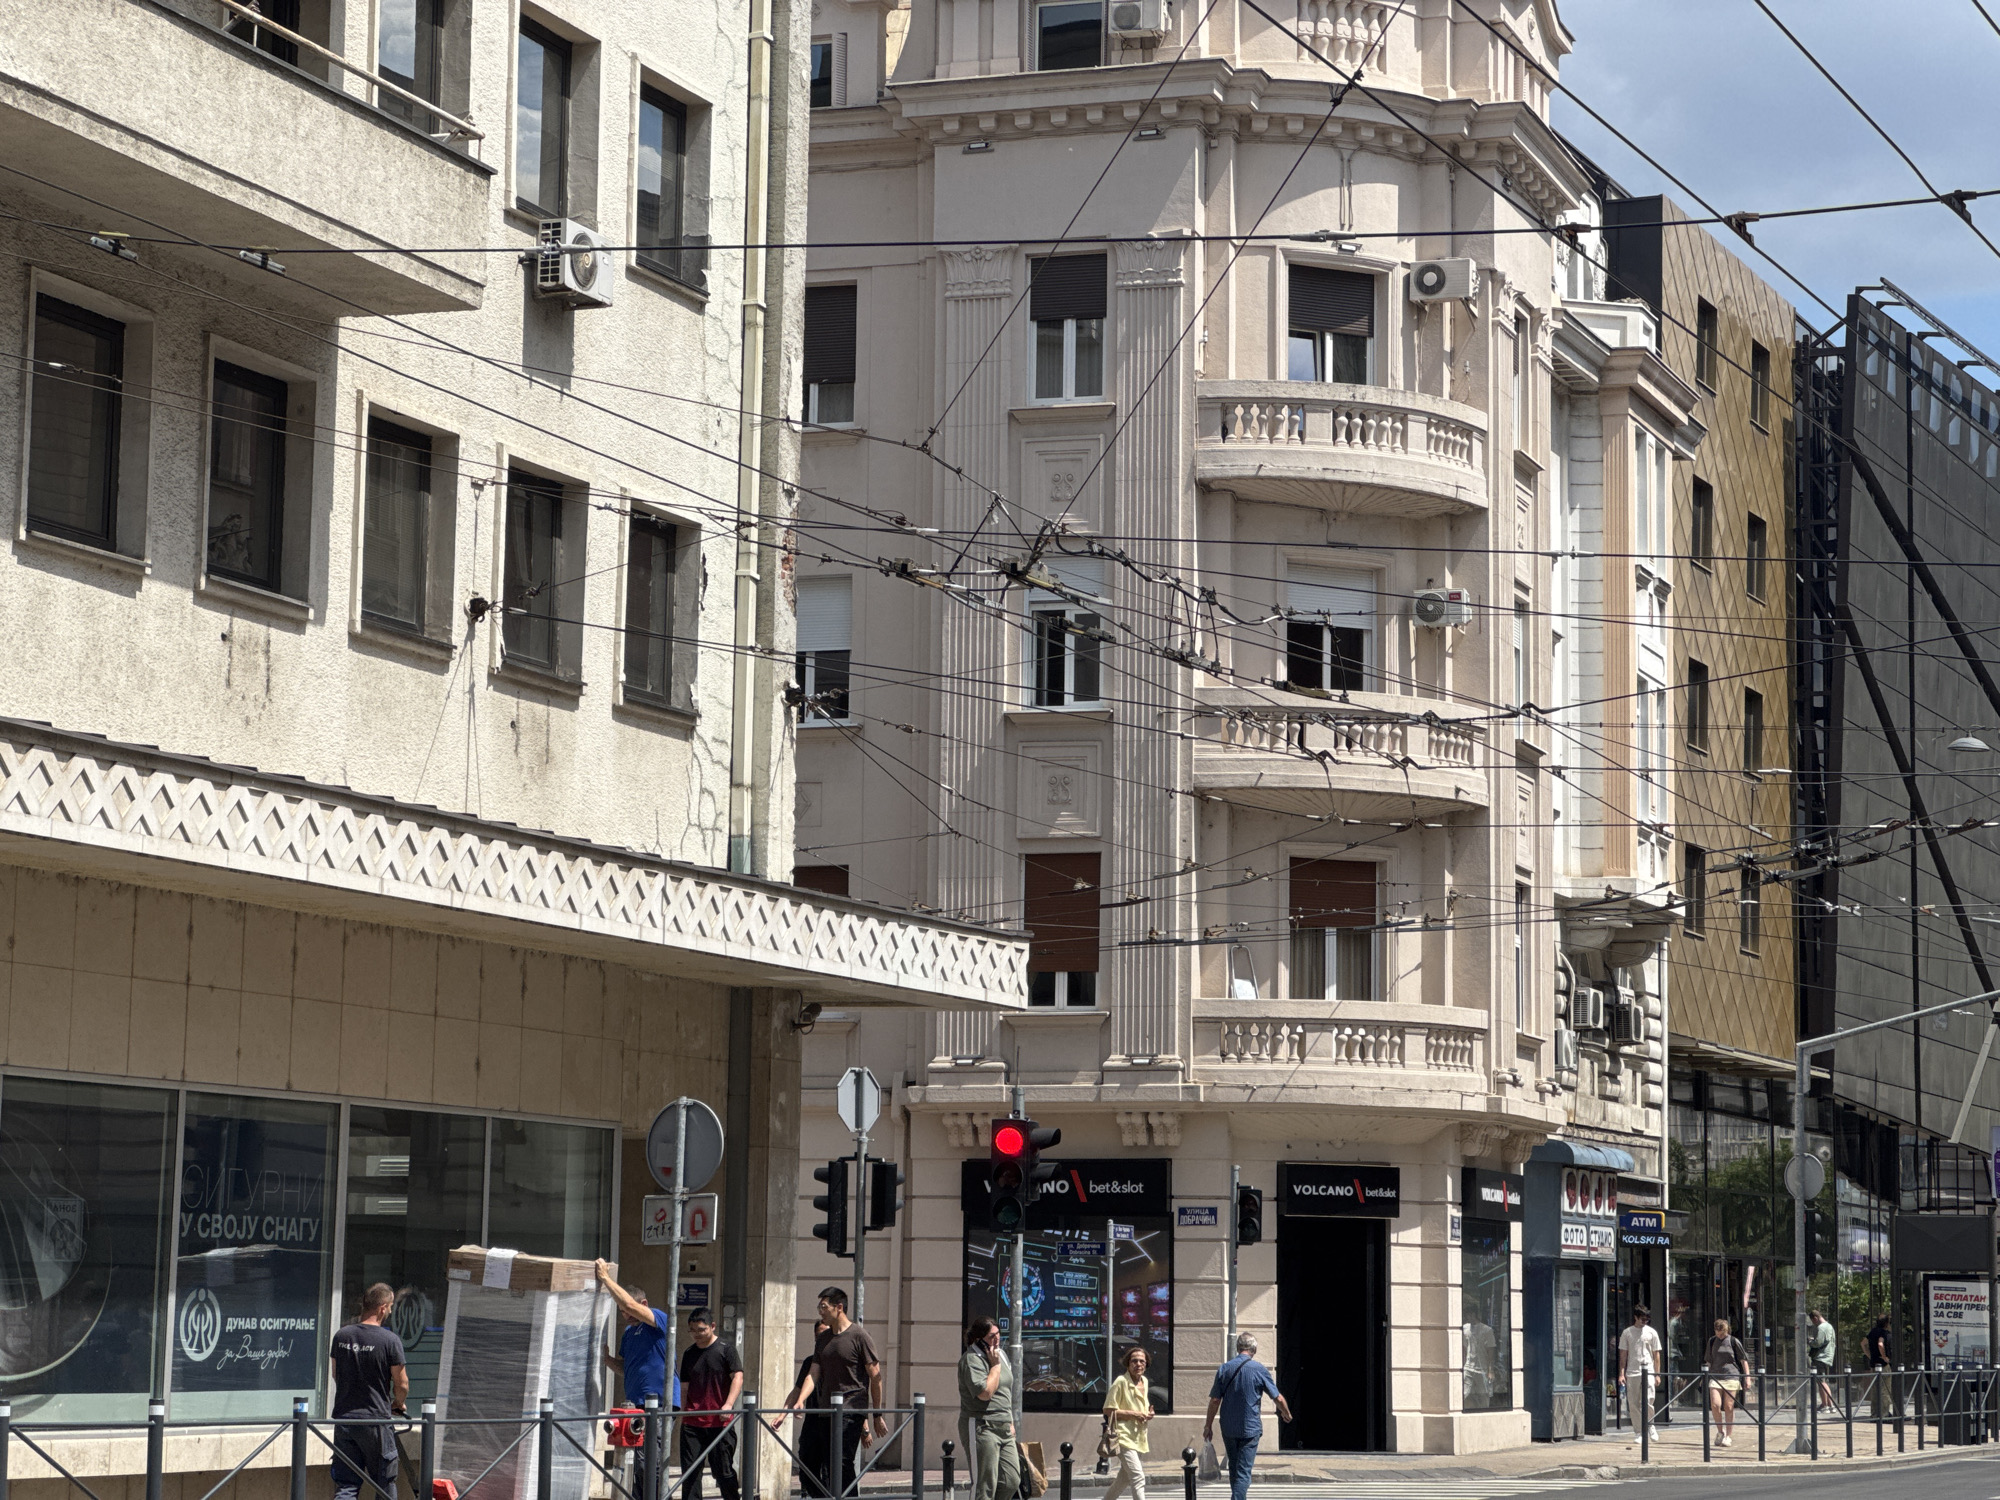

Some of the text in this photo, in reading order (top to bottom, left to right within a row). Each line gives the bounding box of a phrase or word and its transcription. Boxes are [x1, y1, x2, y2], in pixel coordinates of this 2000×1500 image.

[182, 1164, 322, 1213] СИГУРНИ
[1089, 1180, 1144, 1194] bet&slot
[1293, 1184, 1397, 1198] VOLCANO bet&slot
[181, 1212, 320, 1242] У СВОЈУ СНАГУ
[1631, 1217, 1657, 1228] ATM
[1933, 1293, 1987, 1303] БЕСПЛАТАН
[1933, 1302, 1963, 1310] ЈАВНИ
[1933, 1310, 1964, 1319] ЗА СВЕ
[225, 1317, 315, 1332] ДУНАВ ОСИГУРАЊЕ
